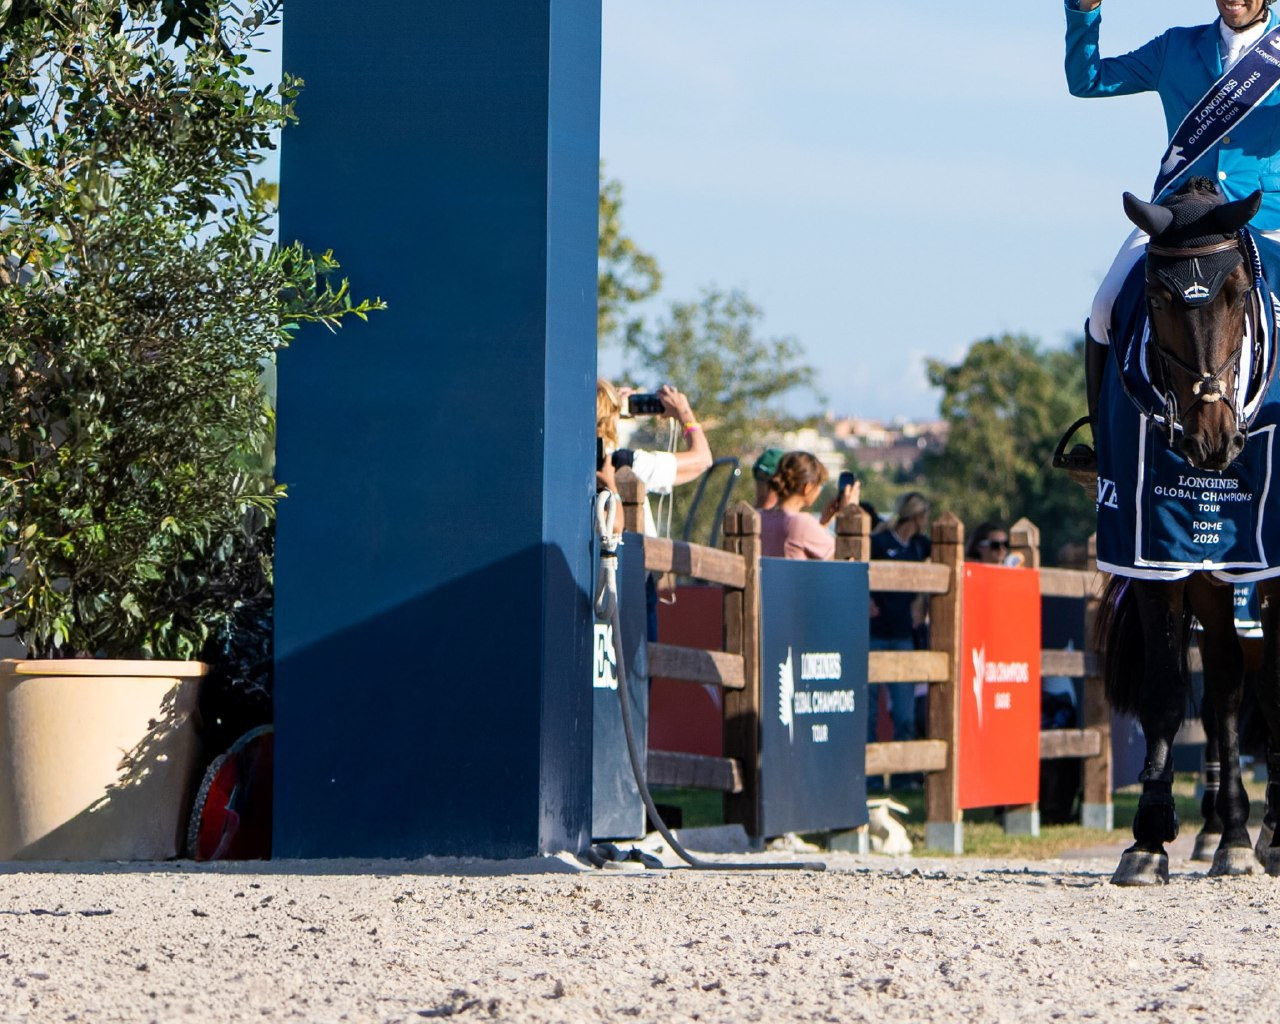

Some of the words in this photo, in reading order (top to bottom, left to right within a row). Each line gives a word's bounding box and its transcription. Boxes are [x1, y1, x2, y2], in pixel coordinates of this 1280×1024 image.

[1189, 116, 1216, 145] GLOBAL
[1216, 71, 1261, 115] CHAMPIONS
[1194, 79, 1238, 123] LONGINES
[1221, 107, 1239, 123] TOUR
[1178, 476, 1239, 490] LONGINES
[1154, 486, 1198, 500] GLOBAL
[1201, 491, 1253, 502] CHAMPIONS
[1199, 504, 1221, 513] TOUR
[1193, 521, 1223, 531] ROME
[1193, 534, 1220, 543] 2026
